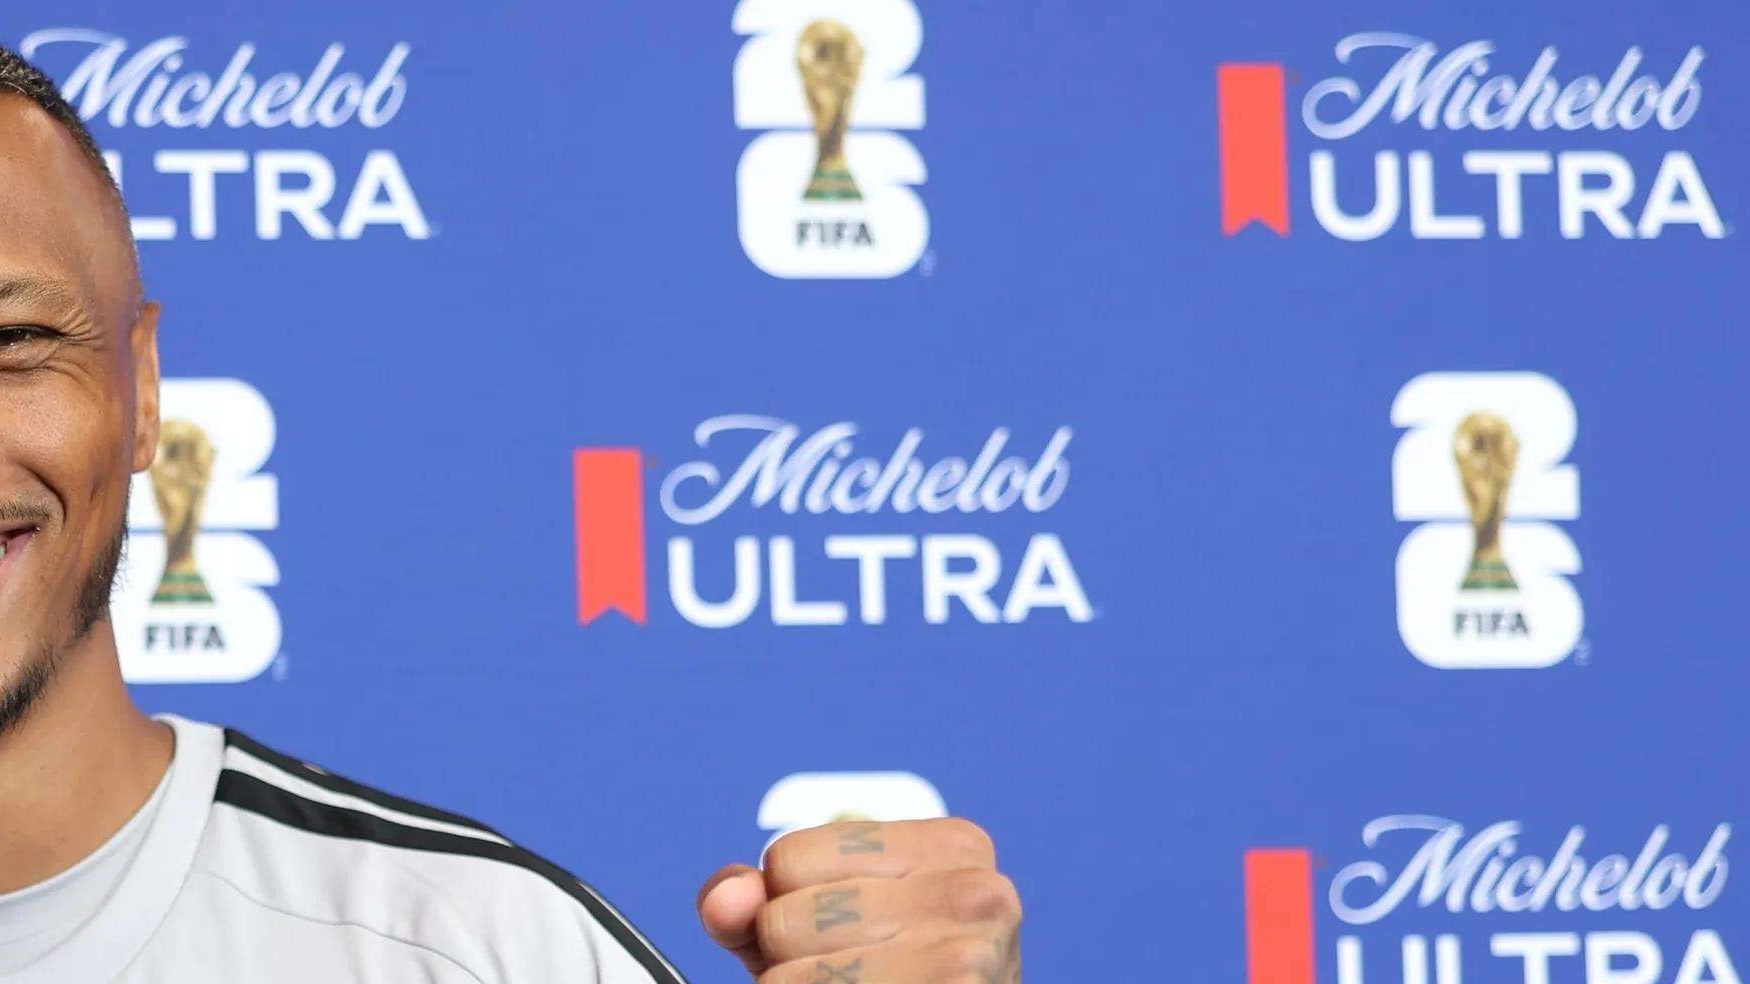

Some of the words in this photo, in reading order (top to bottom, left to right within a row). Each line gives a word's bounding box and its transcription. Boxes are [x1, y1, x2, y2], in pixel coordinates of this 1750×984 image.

[1302, 32, 1705, 140] Michelob
[103, 150, 428, 240] LTRA
[796, 218, 874, 248] FIFA
[1309, 150, 1725, 241] ULTRA
[660, 414, 1073, 525] Michelob
[668, 533, 1092, 628] ULTRA
[1453, 608, 1531, 638] FIFA
[144, 622, 226, 652] FIFA
[1329, 815, 1731, 925] Michelob
